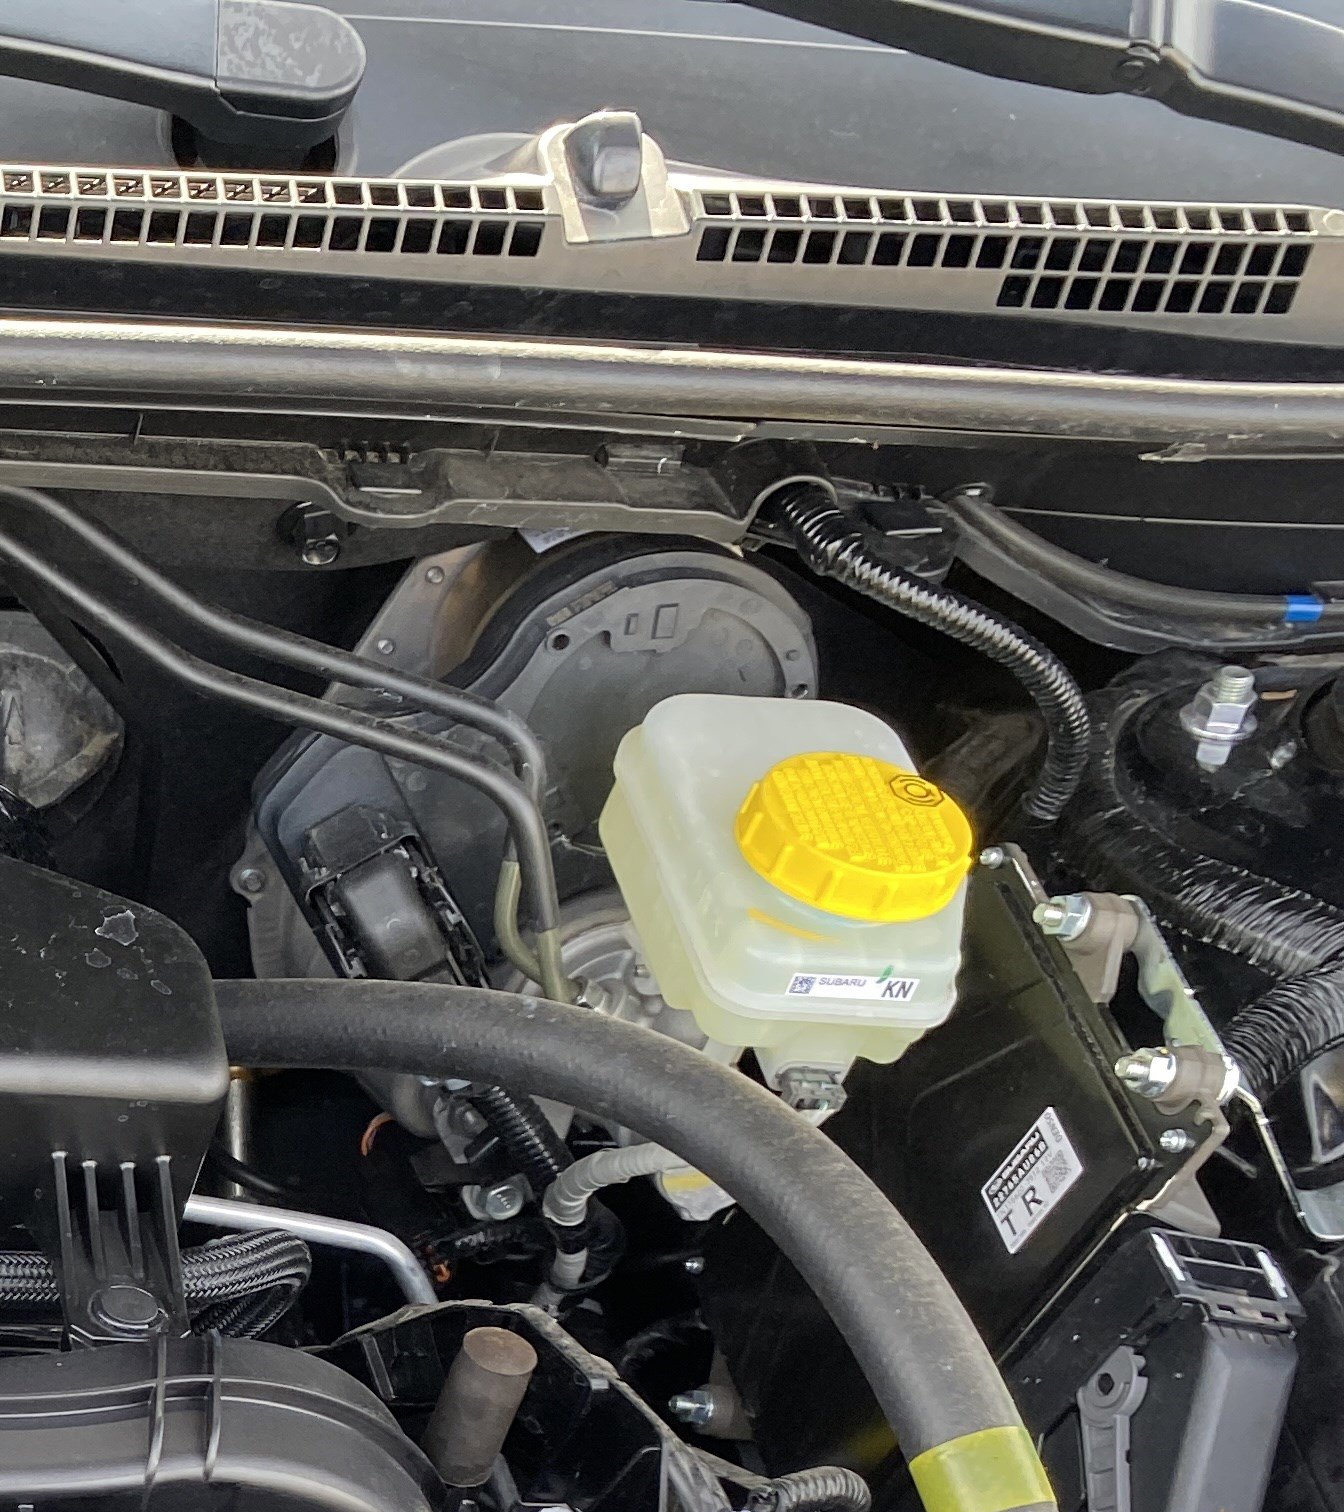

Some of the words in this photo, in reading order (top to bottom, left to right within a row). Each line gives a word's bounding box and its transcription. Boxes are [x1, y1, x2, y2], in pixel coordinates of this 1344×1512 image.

[819, 977, 867, 987] SUBARU
[881, 981, 914, 998] KN
[1000, 1210, 1017, 1236] T
[1022, 1184, 1043, 1216] R
